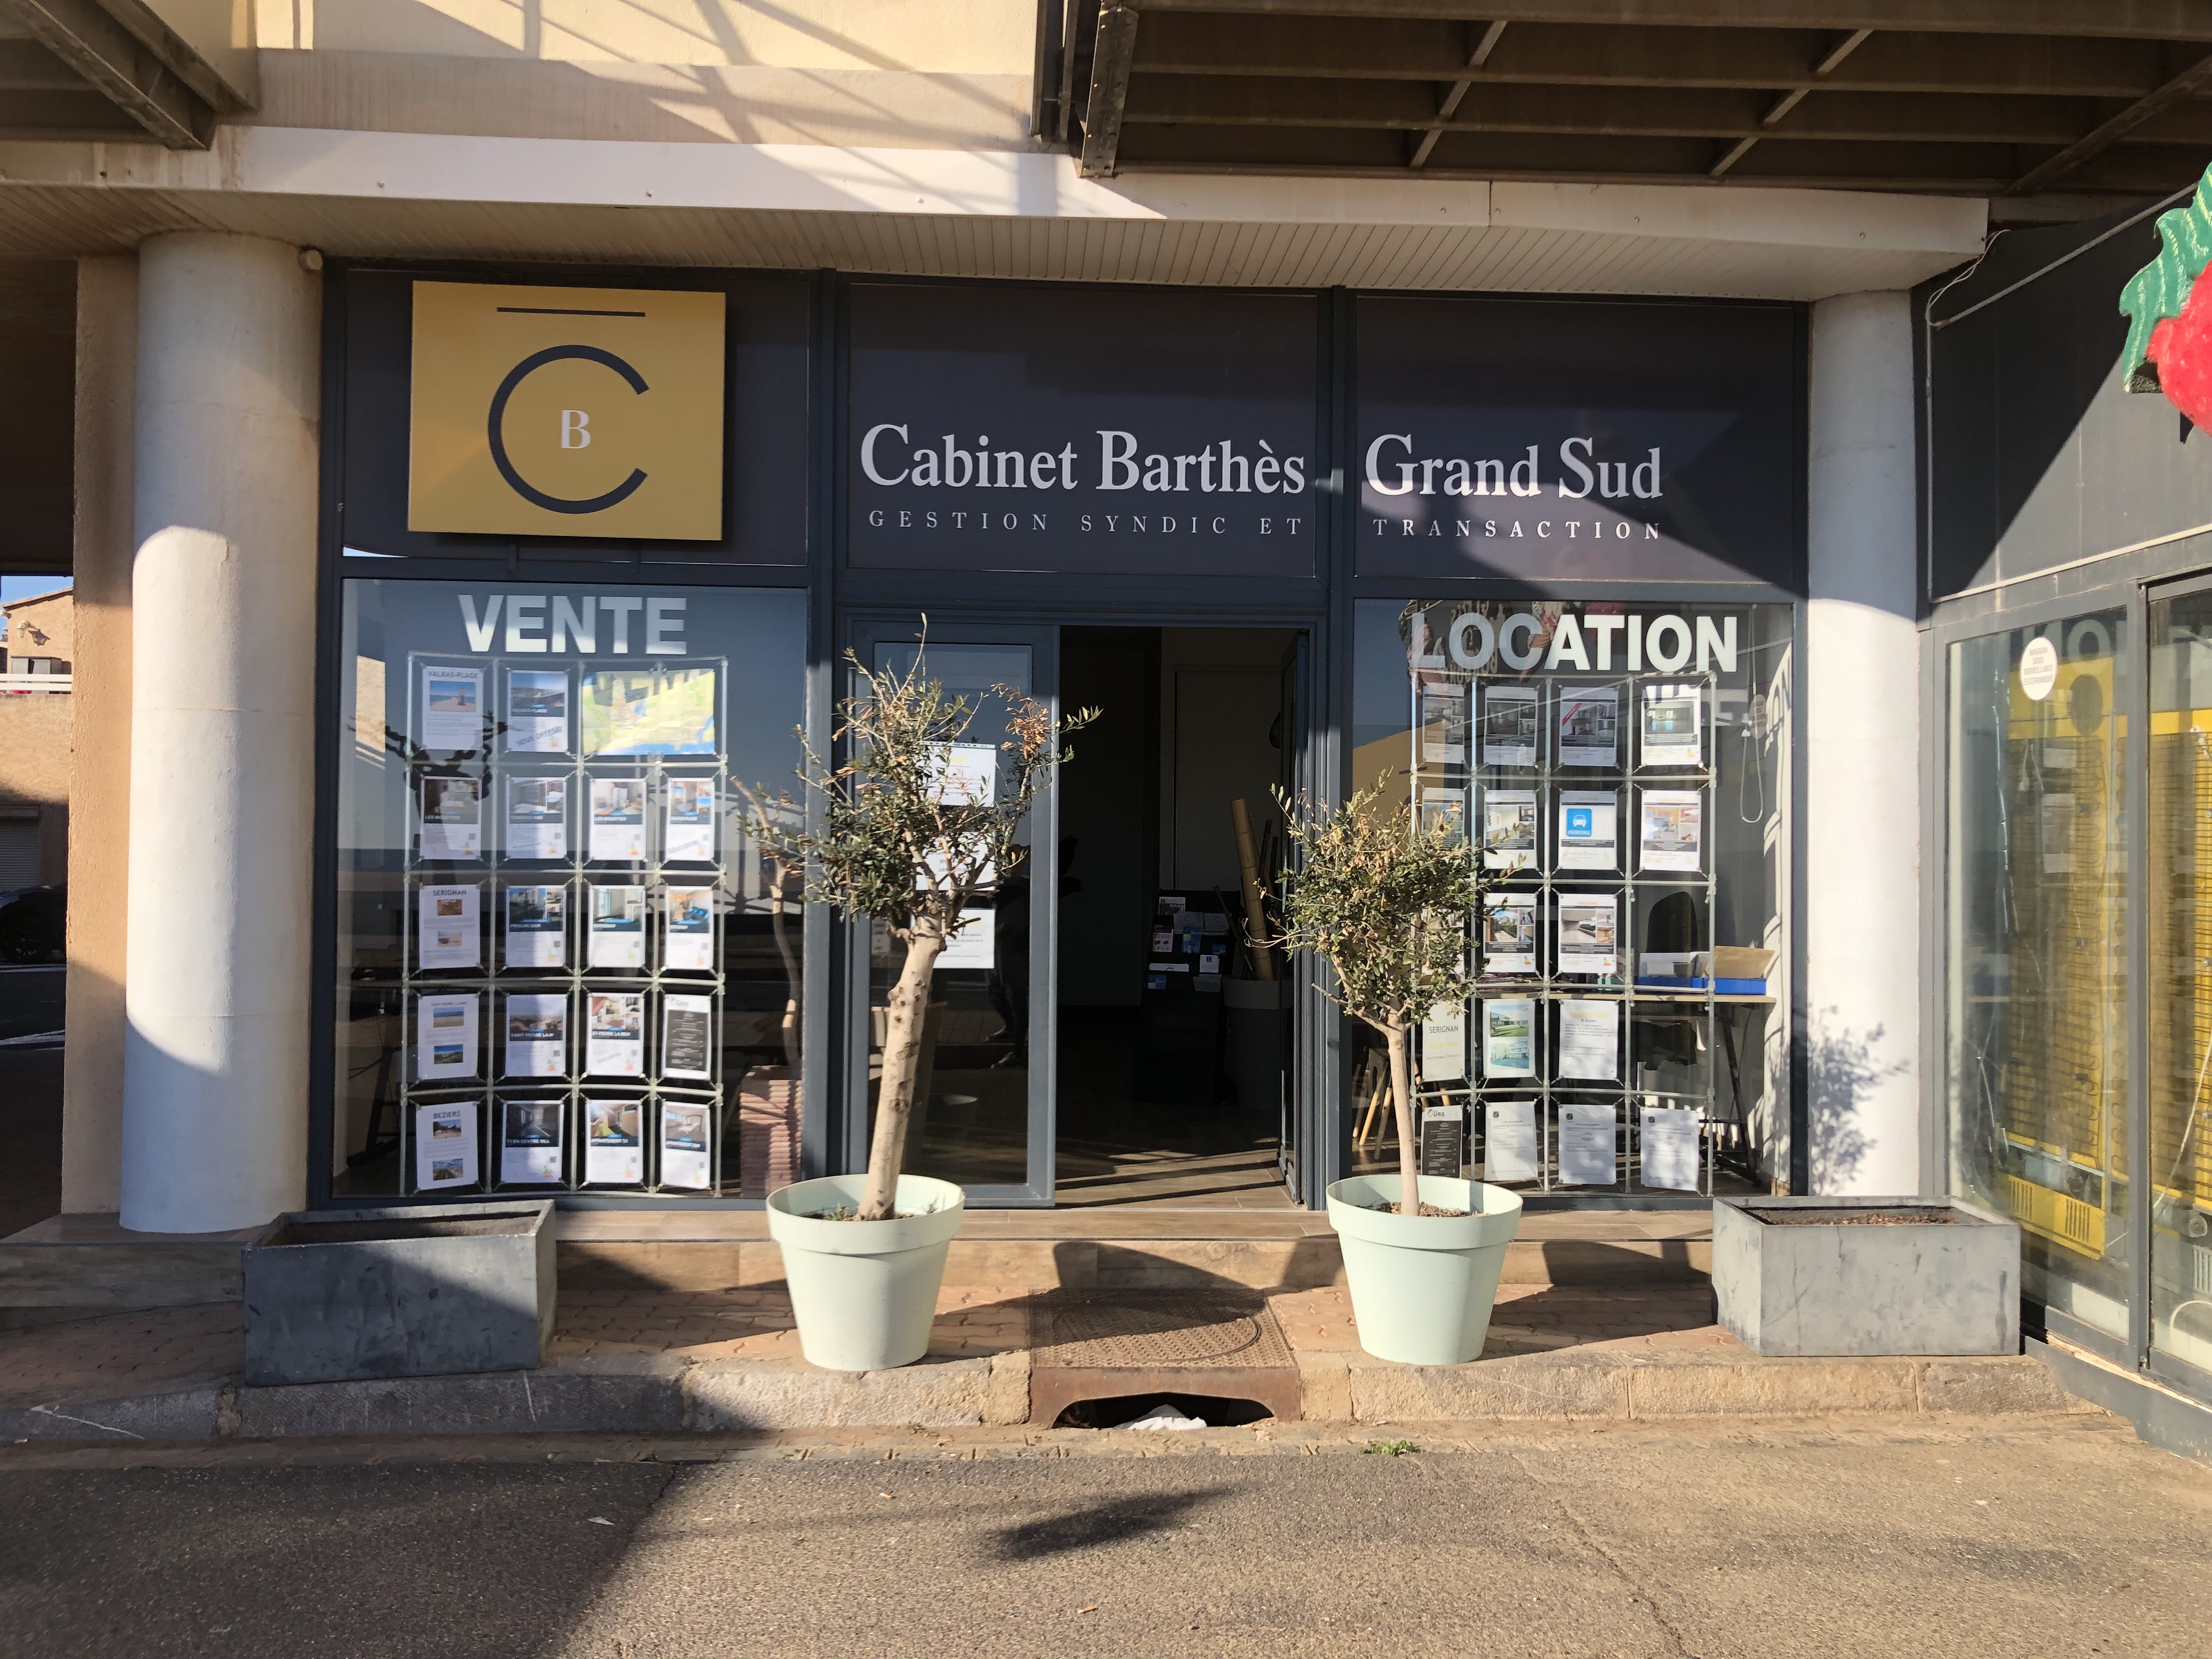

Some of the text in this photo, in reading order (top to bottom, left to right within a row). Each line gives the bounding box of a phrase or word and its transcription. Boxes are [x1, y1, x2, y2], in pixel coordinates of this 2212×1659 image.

[561, 409, 591, 449] B
[861, 424, 1663, 499] Cabinet Barthès Grand Sud
[869, 510, 1660, 540] GESTION SYNDIC ET TRANSACTION
[458, 594, 688, 655] VENTE
[1412, 613, 1737, 673] LOCATION
[1429, 1025, 1458, 1034] SERIGNAN
[433, 1110, 460, 1119] BEZIERS
